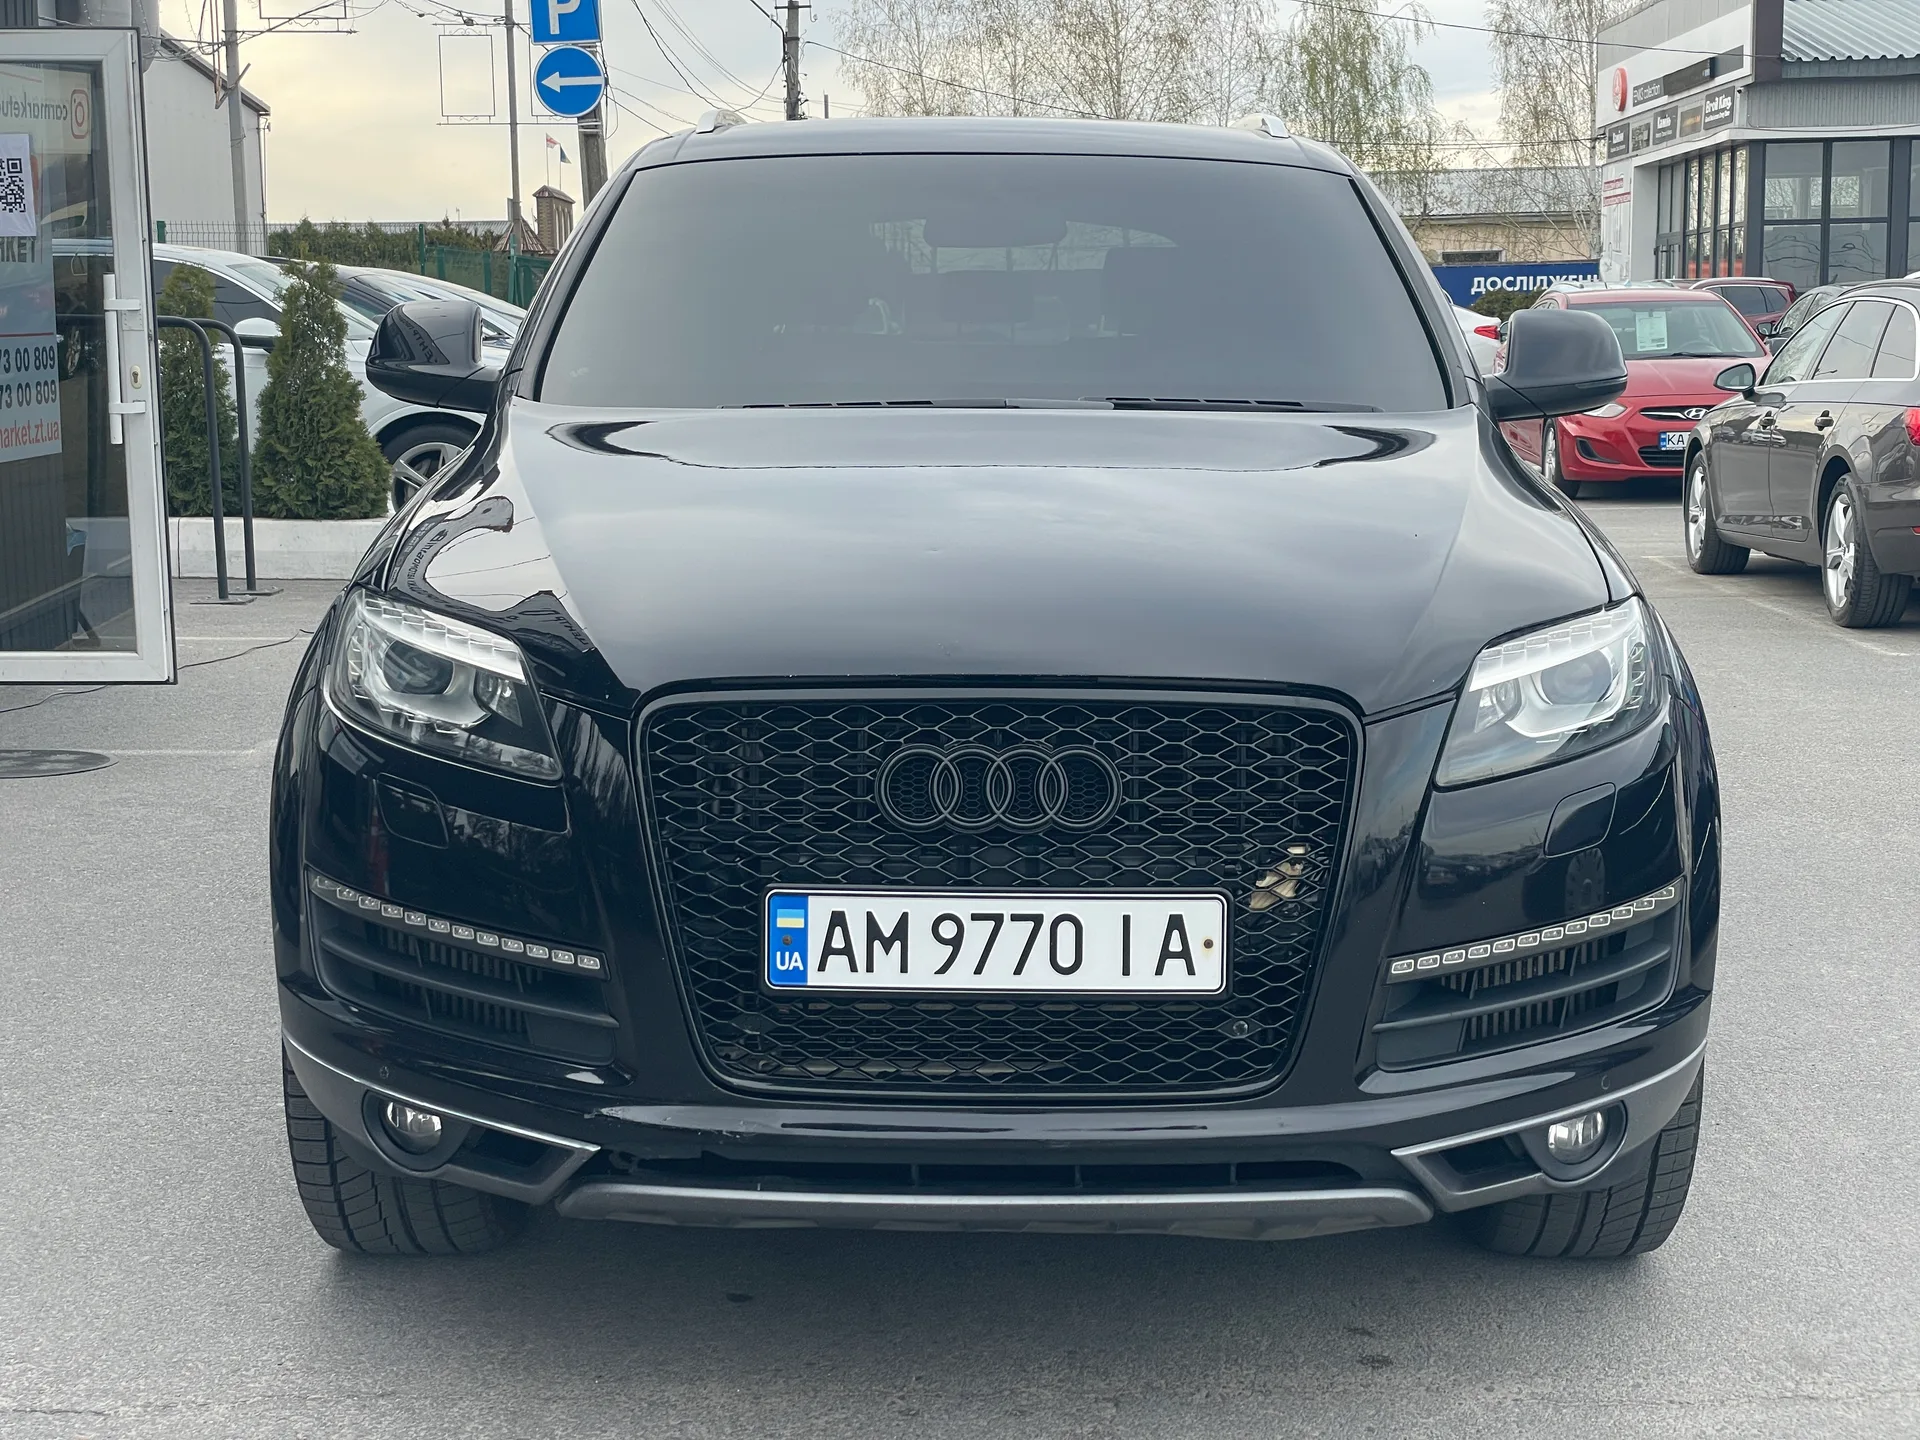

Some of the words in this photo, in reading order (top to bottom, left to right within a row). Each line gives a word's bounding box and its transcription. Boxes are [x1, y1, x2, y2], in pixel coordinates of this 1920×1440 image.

[549, 0, 580, 34] P
[1471, 274, 1598, 295] ДОСЛІД
[15, 347, 30, 372] 00
[34, 346, 55, 370] 809
[17, 382, 31, 407] 00
[36, 380, 57, 405] 809
[1667, 433, 1685, 446] KA
[816, 910, 909, 974] AM
[930, 912, 1084, 976] 9770
[776, 951, 804, 971] UA
